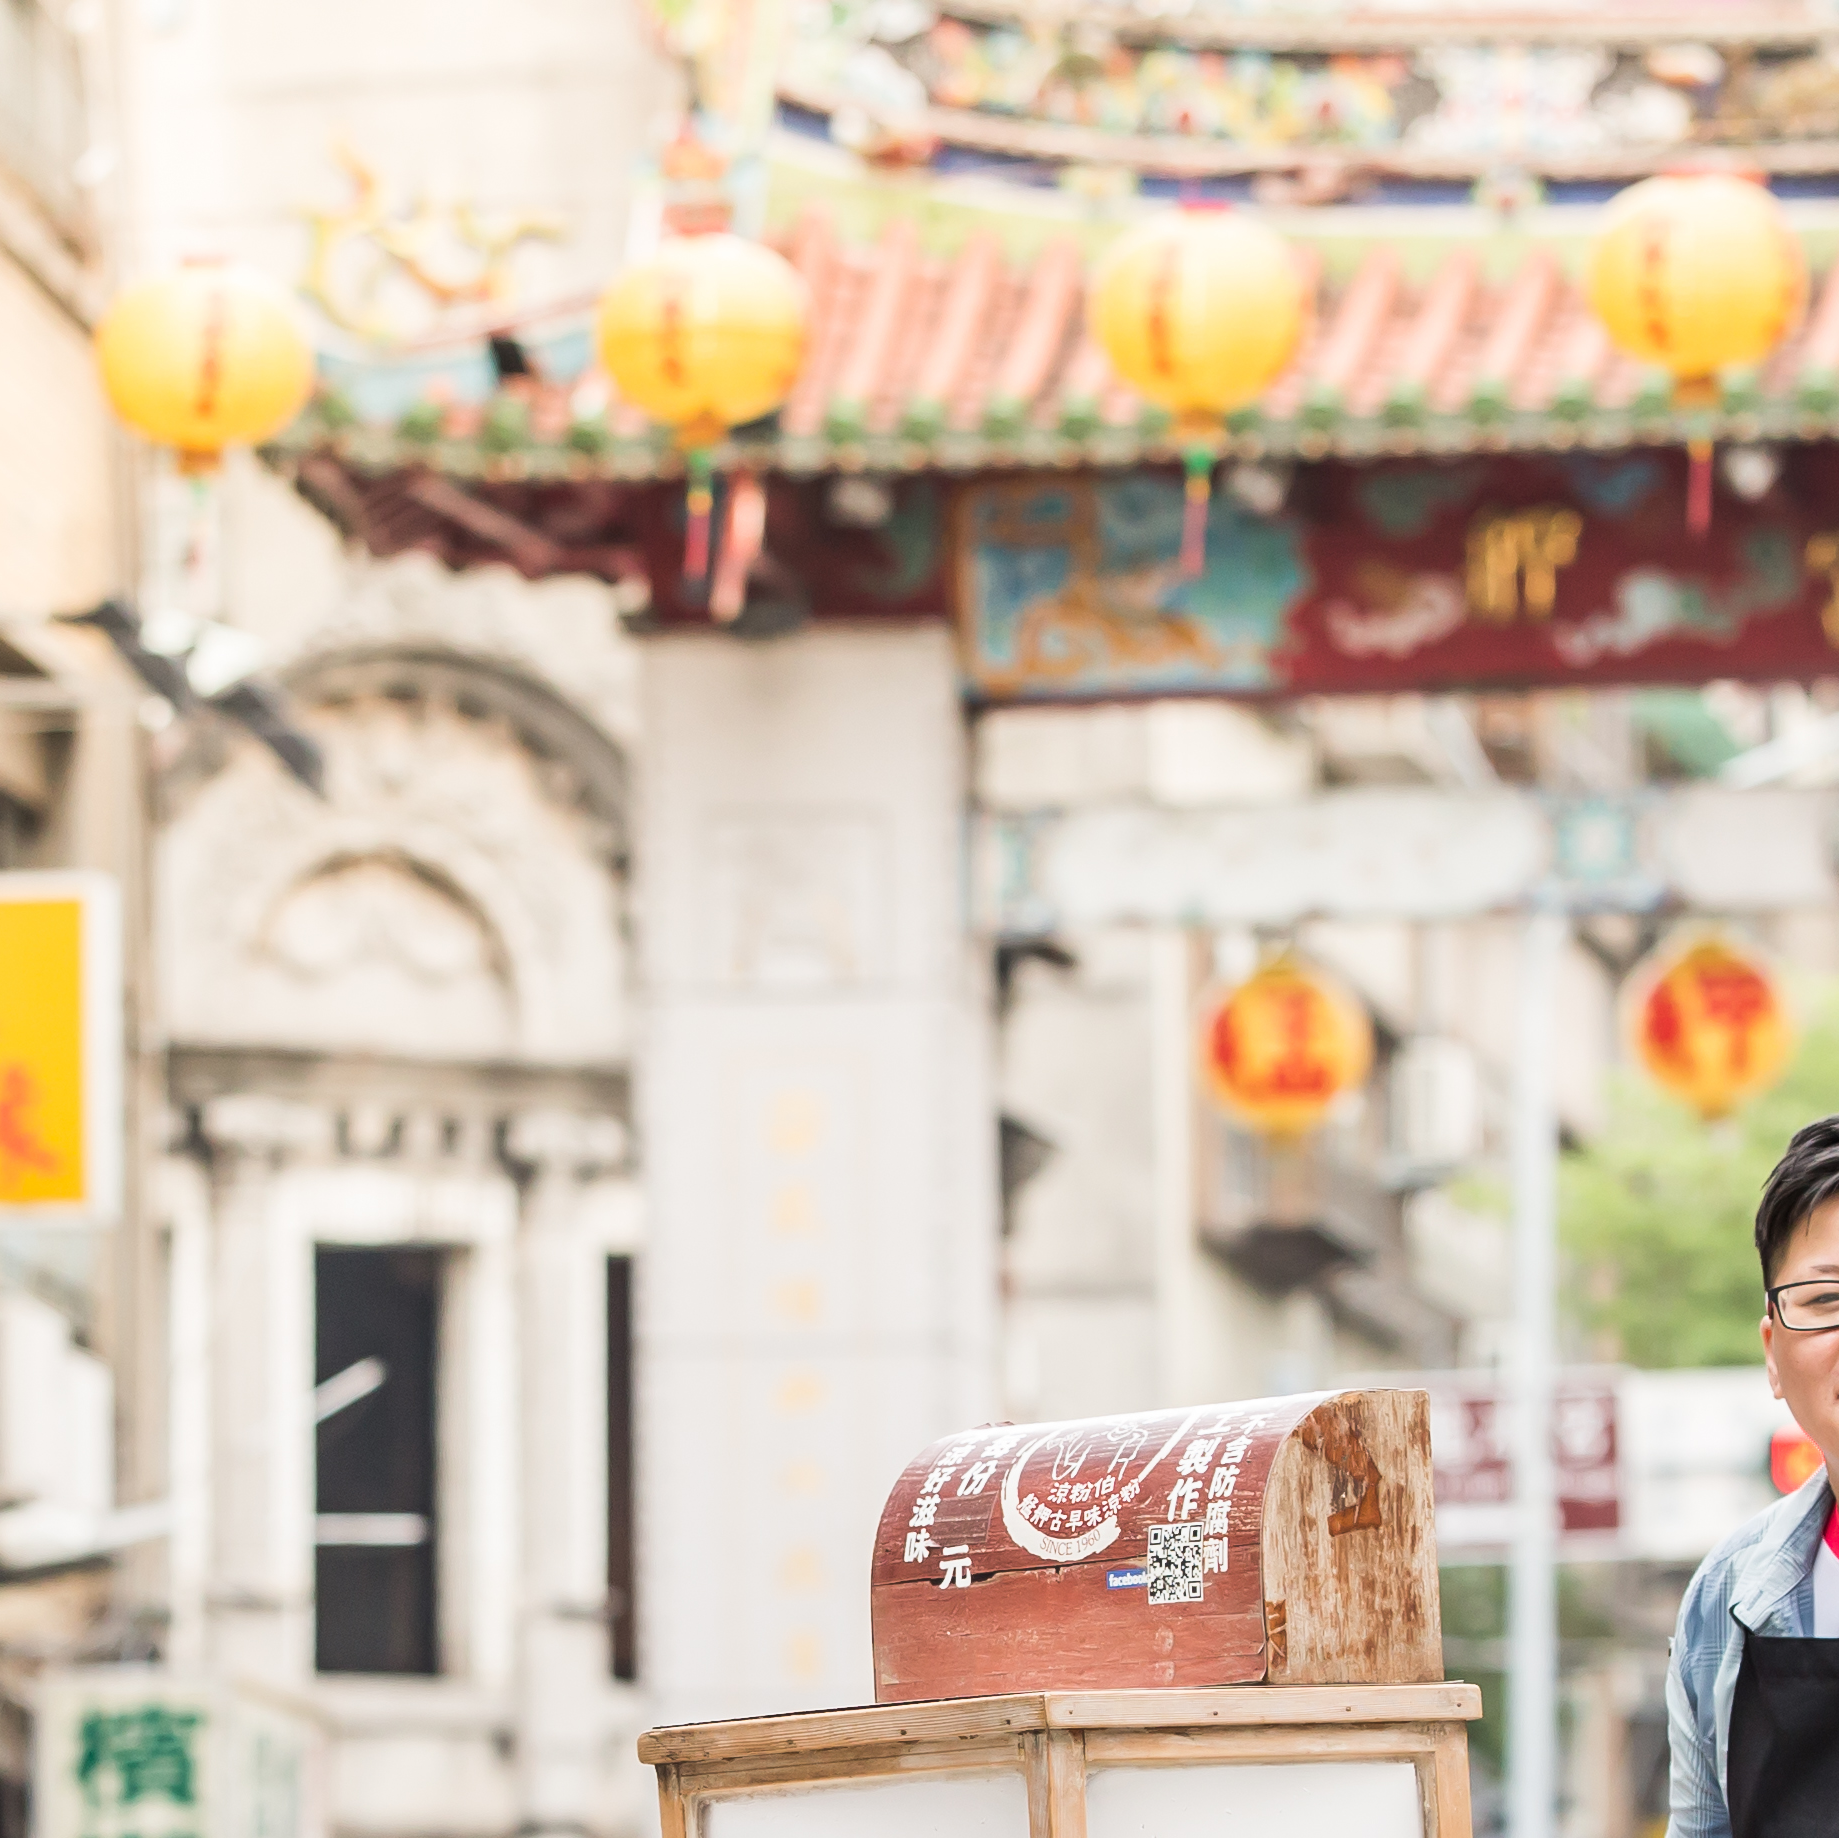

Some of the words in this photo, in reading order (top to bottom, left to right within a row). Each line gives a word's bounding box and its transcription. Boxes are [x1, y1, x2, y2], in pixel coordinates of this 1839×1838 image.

[957, 1433, 1027, 1497] 每份
[1016, 1478, 1141, 1533] 艋舺古早味涼粉
[1047, 1474, 1117, 1505] 涼粉伯
[1203, 1413, 1275, 1574] 不含防腐劑
[1039, 1536, 1073, 1556] SINCE
[1076, 1528, 1101, 1553] 1960
[938, 1544, 972, 1590] 元
[1108, 1571, 1148, 1587] facebook
